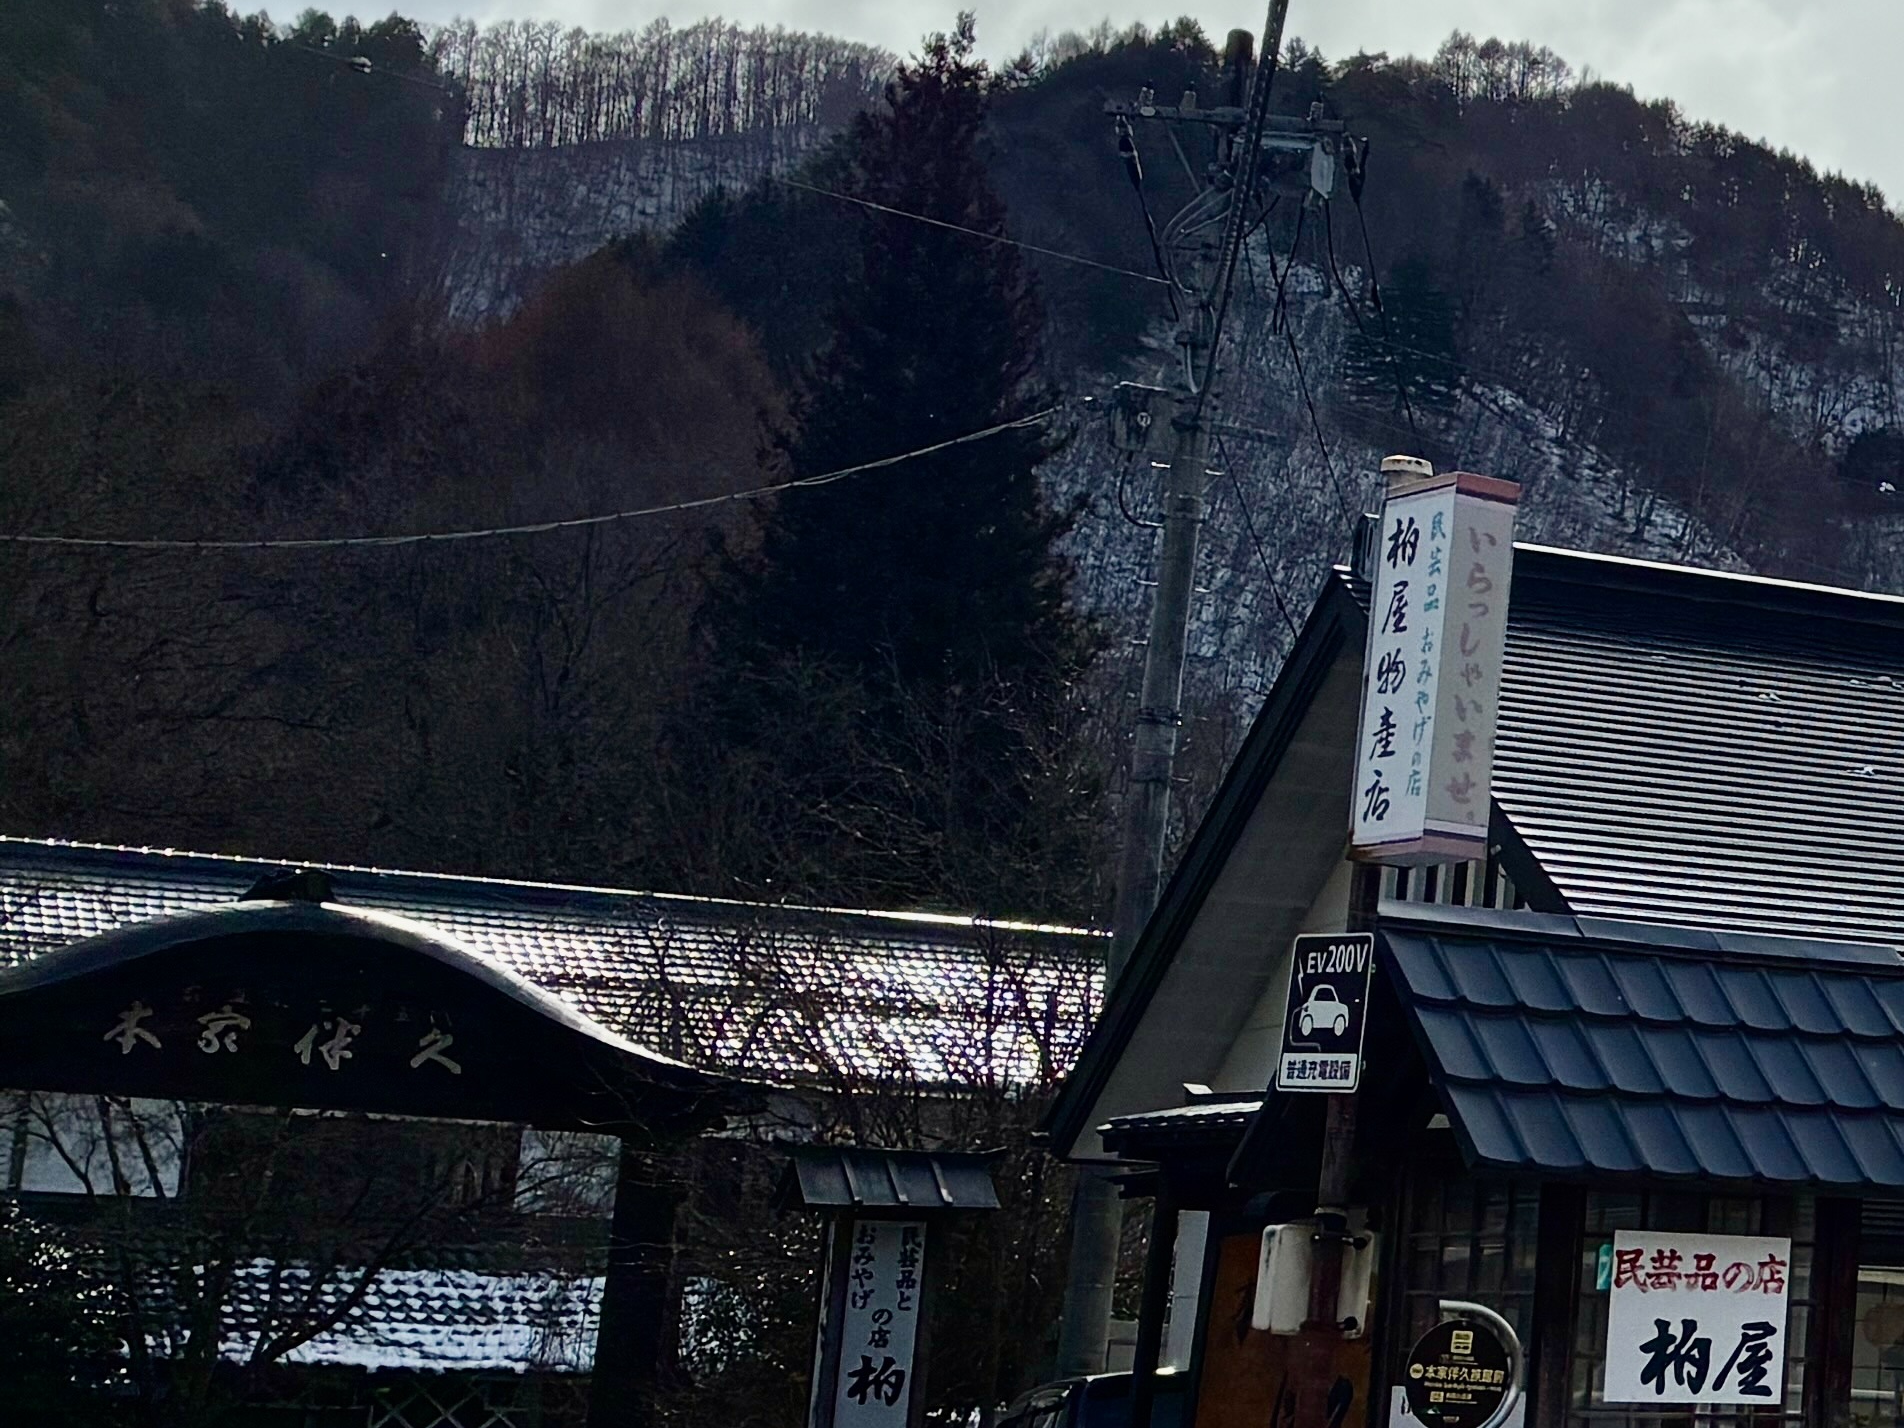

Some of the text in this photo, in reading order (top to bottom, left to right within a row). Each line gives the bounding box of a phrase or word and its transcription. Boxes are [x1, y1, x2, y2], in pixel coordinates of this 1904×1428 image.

[1363, 516, 1421, 823] 柏屋物産店
[850, 1223, 877, 1310] おみやげ
[1613, 1248, 1788, 1295] 民芸品の店
[1639, 1318, 1778, 1397] 柏屋
